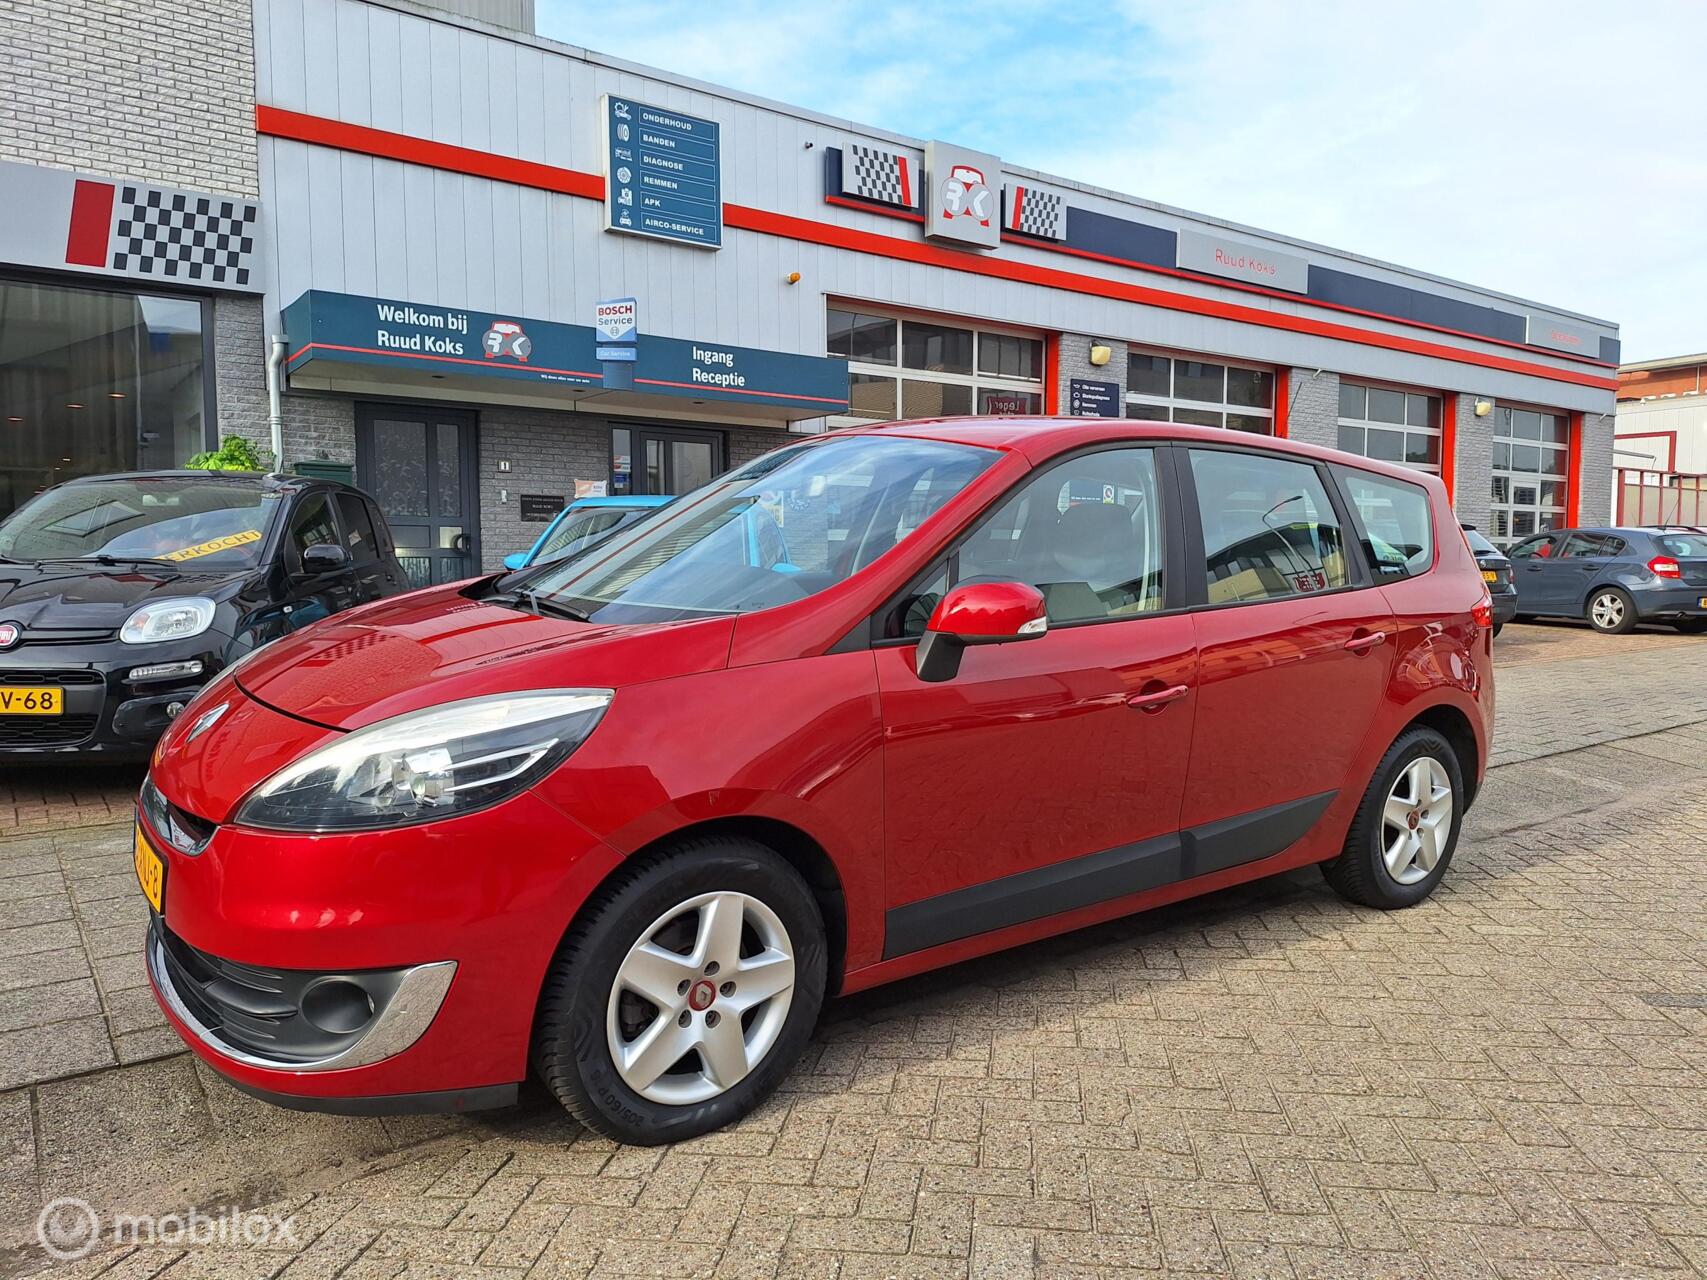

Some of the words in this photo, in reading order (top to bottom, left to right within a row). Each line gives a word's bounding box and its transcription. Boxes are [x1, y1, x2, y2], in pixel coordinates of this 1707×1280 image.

[642, 112, 692, 131] ONDERHOUD
[642, 134, 676, 148] BANDEN
[643, 155, 684, 171] DIAGNOSE
[643, 176, 678, 190] REMMEN
[644, 197, 661, 207] APK
[645, 218, 705, 236] AIRCO-SERVICE
[1215, 248, 1245, 268] Ruud
[598, 304, 633, 316] BOSCH
[377, 304, 444, 329] Welkom
[447, 313, 468, 335] bij
[598, 315, 633, 326] Service
[377, 330, 421, 351] Ruud
[424, 335, 464, 355] Koks
[692, 346, 734, 368] Ingang
[692, 368, 746, 388] Receptie
[164, 531, 260, 560] ERKOCHT
